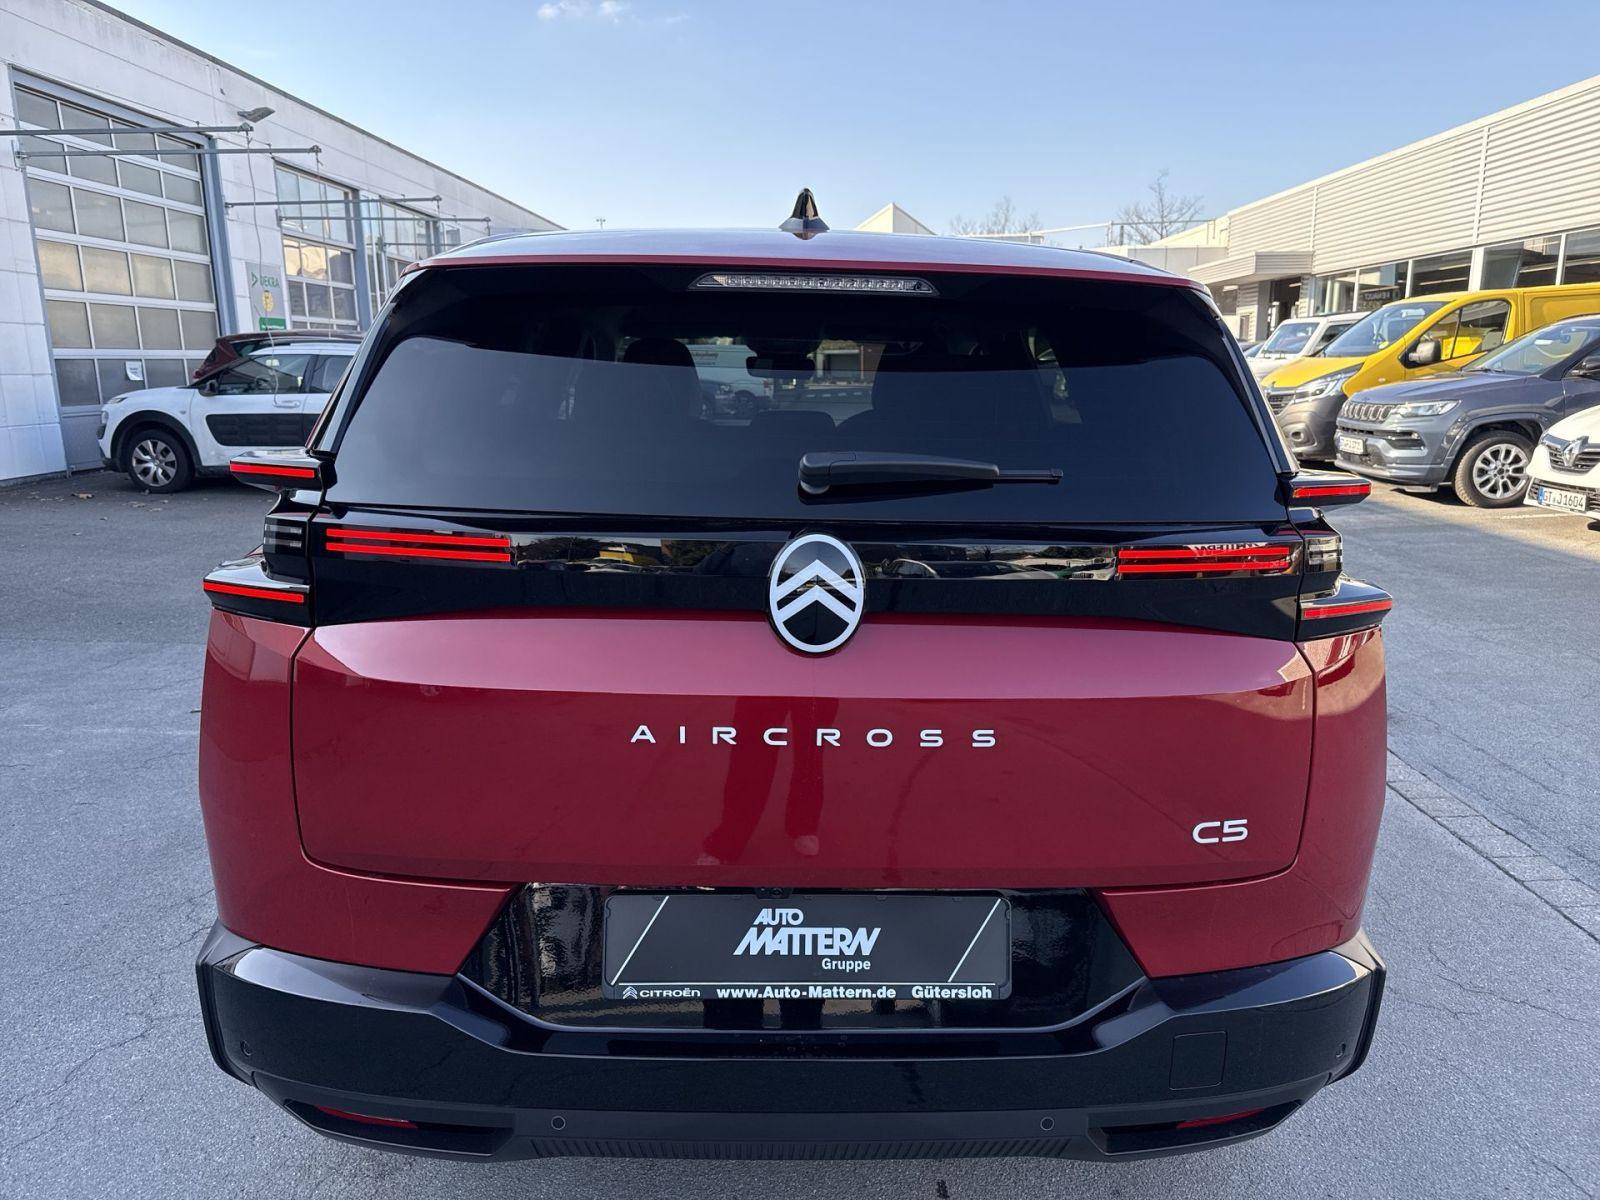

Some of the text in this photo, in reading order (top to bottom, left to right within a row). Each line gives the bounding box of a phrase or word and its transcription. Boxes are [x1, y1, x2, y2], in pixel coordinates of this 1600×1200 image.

[630, 724, 996, 749] AIRCROSS
[1192, 818, 1249, 844] C5
[753, 908, 804, 926] AUTO
[733, 927, 882, 956] MATTERN
[821, 957, 872, 973] Gruppe
[639, 984, 993, 999] CITROËN www.Auto-Mattern.de Gütersloh
